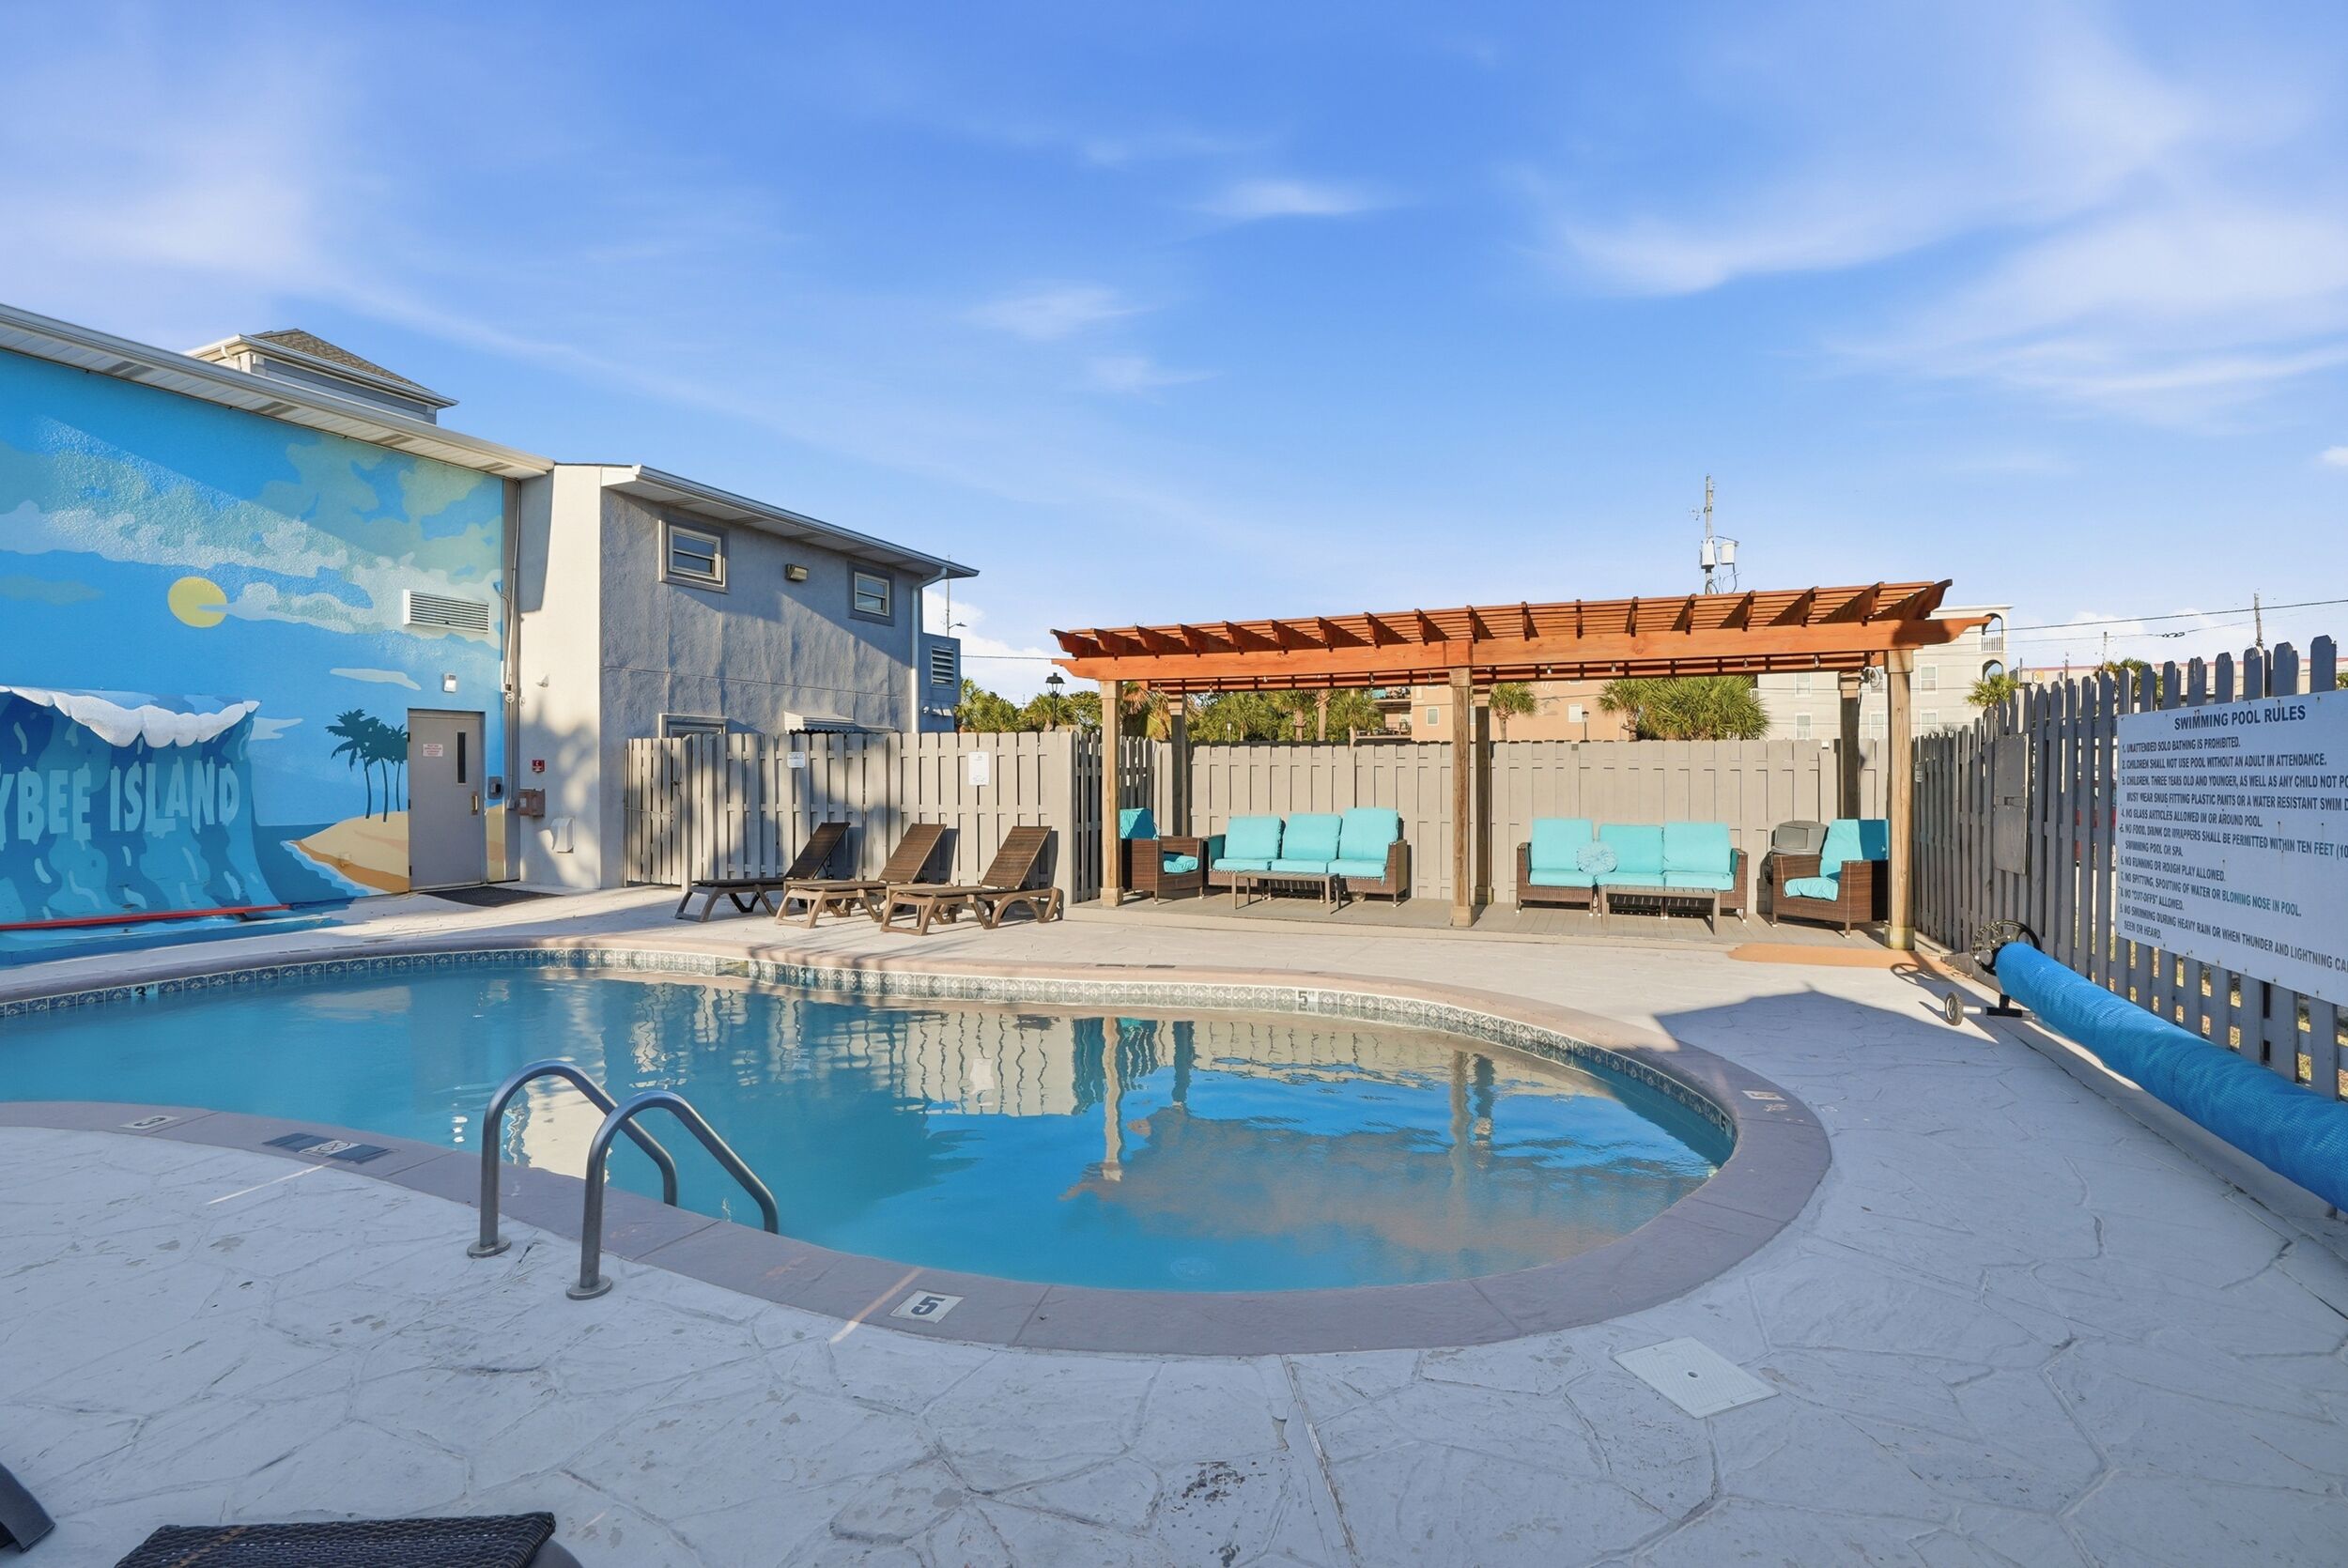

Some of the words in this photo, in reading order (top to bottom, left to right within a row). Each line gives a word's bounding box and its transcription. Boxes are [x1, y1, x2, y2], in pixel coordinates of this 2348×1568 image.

[2174, 713, 2228, 730] SWIMMING
[2232, 710, 2261, 726] POOL
[2264, 705, 2306, 723] RULES
[2126, 742, 2156, 753] UNATTENDED
[2158, 741, 2170, 751] SOLO
[2172, 739, 2196, 751] BATHING
[2198, 739, 2202, 749] IS
[2204, 736, 2240, 749] PROHIBITED.
[2126, 759, 2149, 770] CHILDREN
[2150, 759, 2166, 769] SHALL
[2167, 759, 2177, 768] NOT
[2179, 758, 2189, 768] USE
[2190, 757, 2205, 768] POOL
[2207, 757, 2233, 767] WITHOUT
[2235, 756, 2243, 767] AN
[2245, 755, 2265, 767] ADULT
[2267, 755, 2275, 766] IN
[2276, 753, 2327, 766] ATTENDANCE.
[2151, 776, 2167, 786] THREE
[2169, 776, 2182, 786] YEARS
[2183, 776, 2194, 786] OLD
[2196, 776, 2207, 786] AND
[2208, 776, 2239, 789] YOUNGER,
[2240, 776, 2248, 787] AS
[2249, 776, 2266, 787] WELL
[2268, 776, 2277, 787] AS
[2278, 776, 2294, 787] ANY
[2294, 776, 2318, 788] CHILD
[2320, 776, 2337, 789] NOT
[110, 756, 239, 838] ISLAND
[2126, 792, 2139, 802] MUST
[2139, 792, 2153, 802] WEAR
[2170, 793, 2190, 804] FITTING
[2191, 793, 2216, 805] PLASTIC
[2217, 794, 2235, 806] PANTS
[2237, 795, 2246, 807] OR
[2247, 795, 2251, 807] A
[2252, 795, 2275, 807] WATER
[2277, 796, 2318, 809] RESISTANT
[2320, 797, 2341, 811] SWIM
[2126, 809, 2133, 818] NO
[2134, 809, 2148, 819] GLASS
[2149, 809, 2172, 821] ARTICLES
[2173, 810, 2199, 822] ALLOWED
[2201, 812, 2207, 822] IN
[2208, 812, 2217, 823] OR
[2218, 813, 2243, 826] AROUND
[2245, 815, 2263, 827] POOL.
[2124, 824, 2131, 834] NO
[2147, 826, 2162, 838] DRINK
[2164, 827, 2171, 838] OR
[2171, 828, 2201, 841] WRAPPERS
[2201, 831, 2221, 843] SHALL
[2222, 833, 2232, 844] BE
[2232, 834, 2267, 849] PERMITTED
[2270, 837, 2294, 852] WITHIN
[2296, 840, 2311, 854] TEN
[2314, 842, 2334, 856] FEET
[2125, 840, 2149, 852] SWIMMING
[2150, 843, 2162, 853] POOL
[2164, 845, 2171, 855] OR
[2172, 846, 2183, 856] SPA.
[2124, 856, 2131, 866] NO
[2133, 857, 2153, 869] RUNNING
[2155, 861, 2161, 871] OR
[2162, 861, 2180, 874] ROUGH
[2182, 865, 2196, 876] PLAY
[2196, 866, 2226, 882] ALLOWED.
[2124, 872, 2131, 882] NO
[2155, 878, 2181, 892] SPOUTING
[2183, 883, 2189, 894] OF
[2191, 884, 2210, 898] WATER
[2212, 888, 2220, 900] OR
[2222, 890, 2250, 906] BLOWING
[2252, 896, 2271, 911] NOSE
[2272, 900, 2279, 912] IN
[2281, 902, 2301, 917] POOL.
[2124, 888, 2131, 899] NO
[2158, 896, 2185, 911] ALLOWED.
[2124, 905, 2130, 915] NO
[2131, 906, 2155, 922] SWIMMING
[2156, 913, 2176, 927] DURING
[2178, 916, 2195, 930] HEAVY
[2197, 922, 2211, 935] RAIN
[2212, 926, 2220, 938] OR
[2222, 927, 2240, 943] WHEN
[2242, 933, 2273, 951] THUNDER
[2275, 941, 2289, 957] AND
[2291, 945, 2332, 969] LIGHTNING
[2137, 923, 2142, 934] OR
[2144, 925, 2162, 939] HEARD.
[911, 1296, 946, 1314] 5
